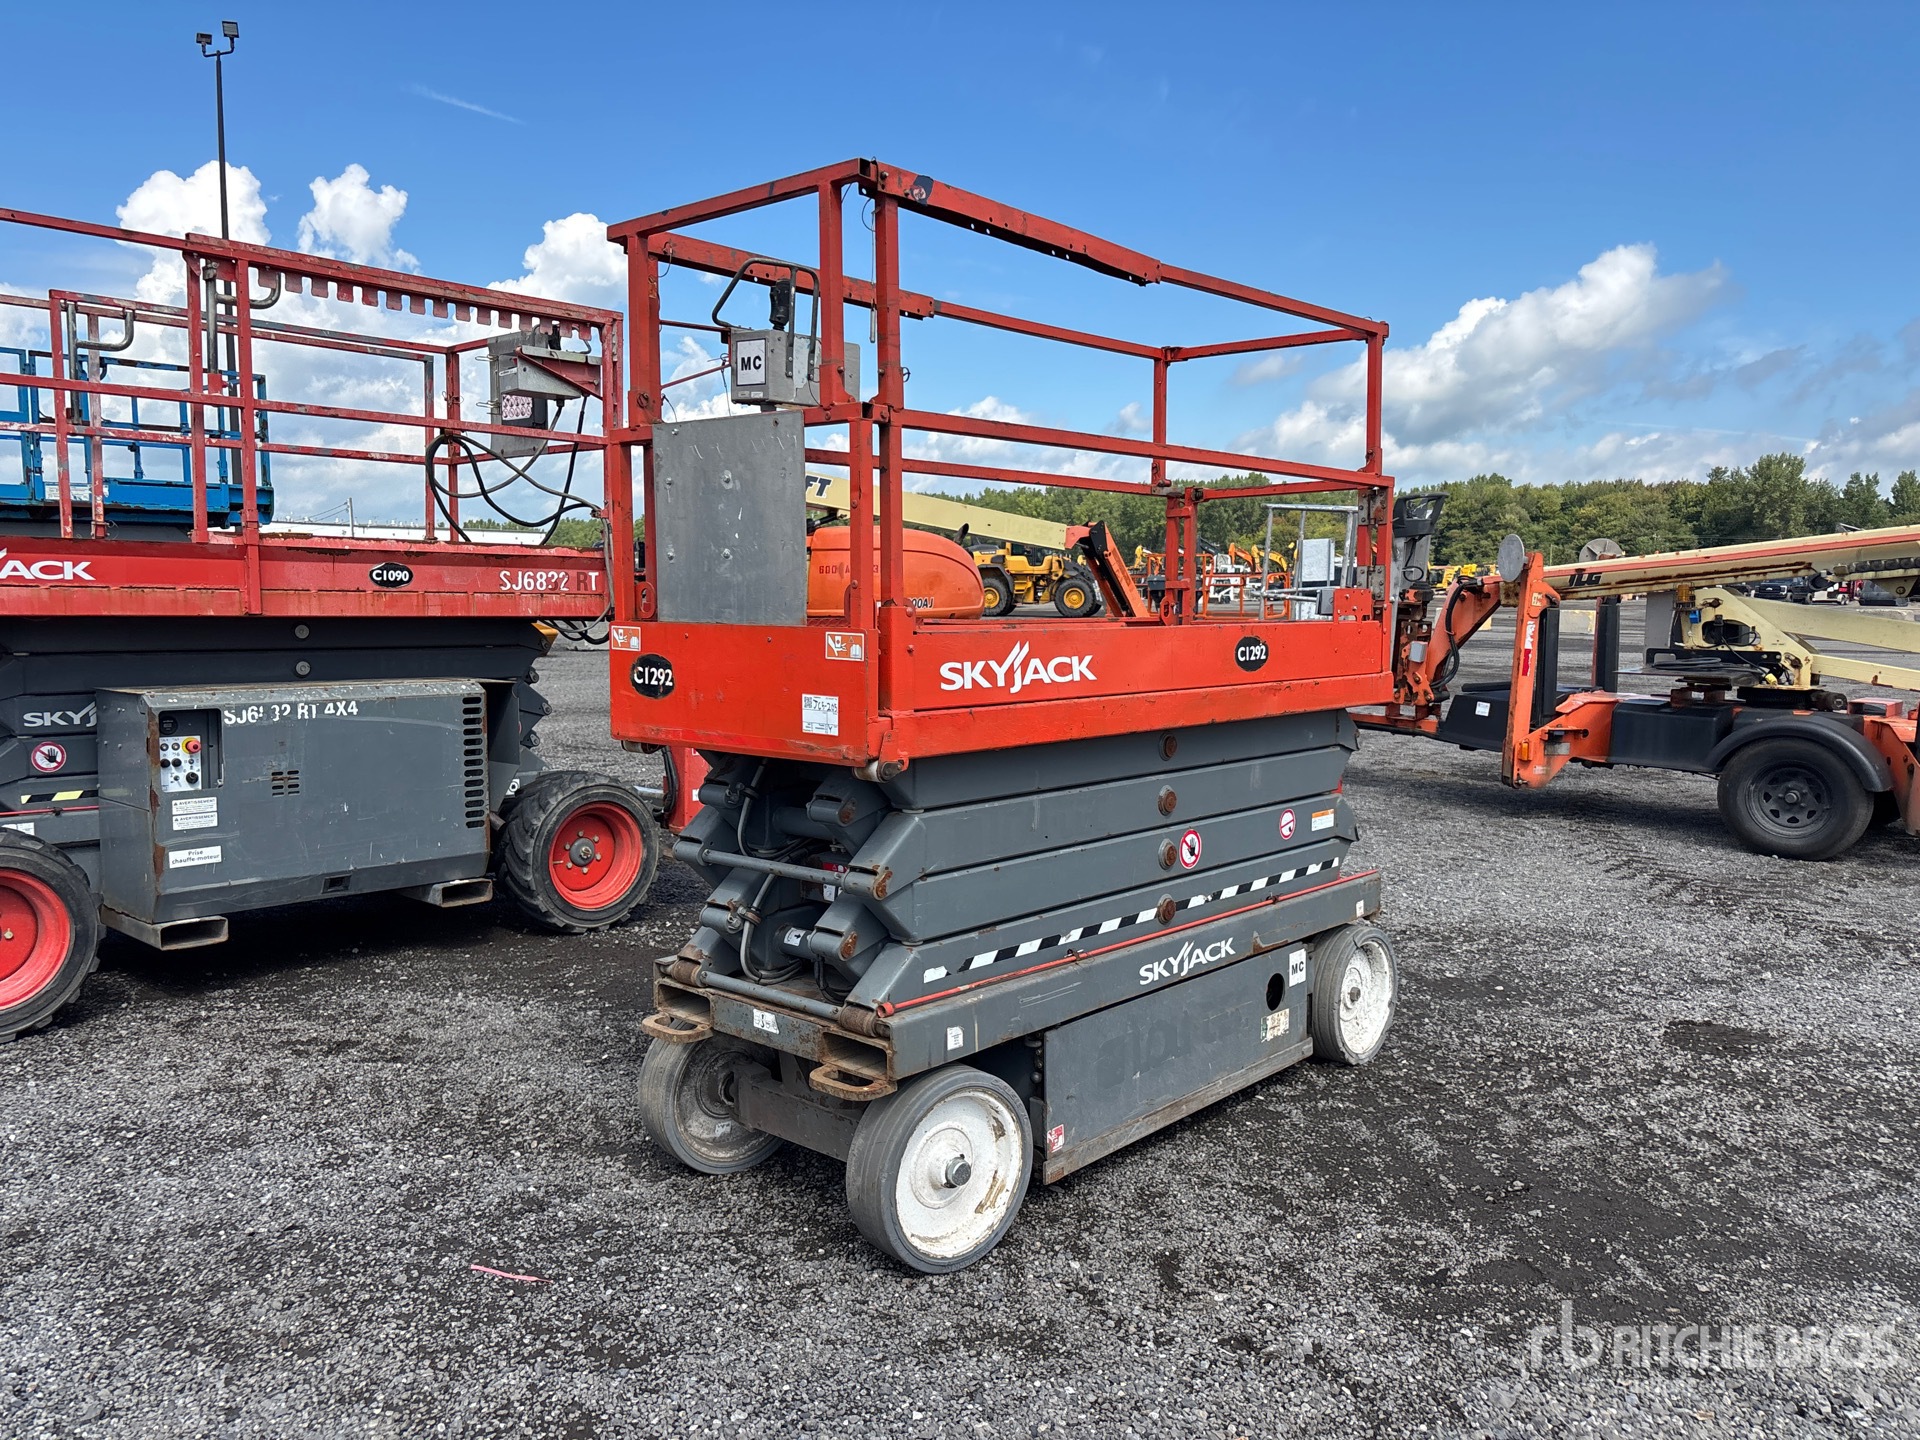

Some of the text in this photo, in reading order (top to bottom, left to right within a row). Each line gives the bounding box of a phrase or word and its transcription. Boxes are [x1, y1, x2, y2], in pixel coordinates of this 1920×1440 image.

[741, 355, 762, 371] MC
[804, 475, 832, 497] FT
[0, 549, 97, 581] ACK
[372, 569, 410, 582] C1090
[911, 597, 934, 609] 00AJ
[1237, 645, 1267, 662] C1292
[939, 640, 1098, 694] SKYJACK
[634, 666, 674, 687] C1292
[324, 700, 359, 717] 4X4
[171, 854, 220, 865] chauffe-moteur
[1139, 937, 1236, 986] SKYJACK
[1291, 961, 1305, 976] MC
